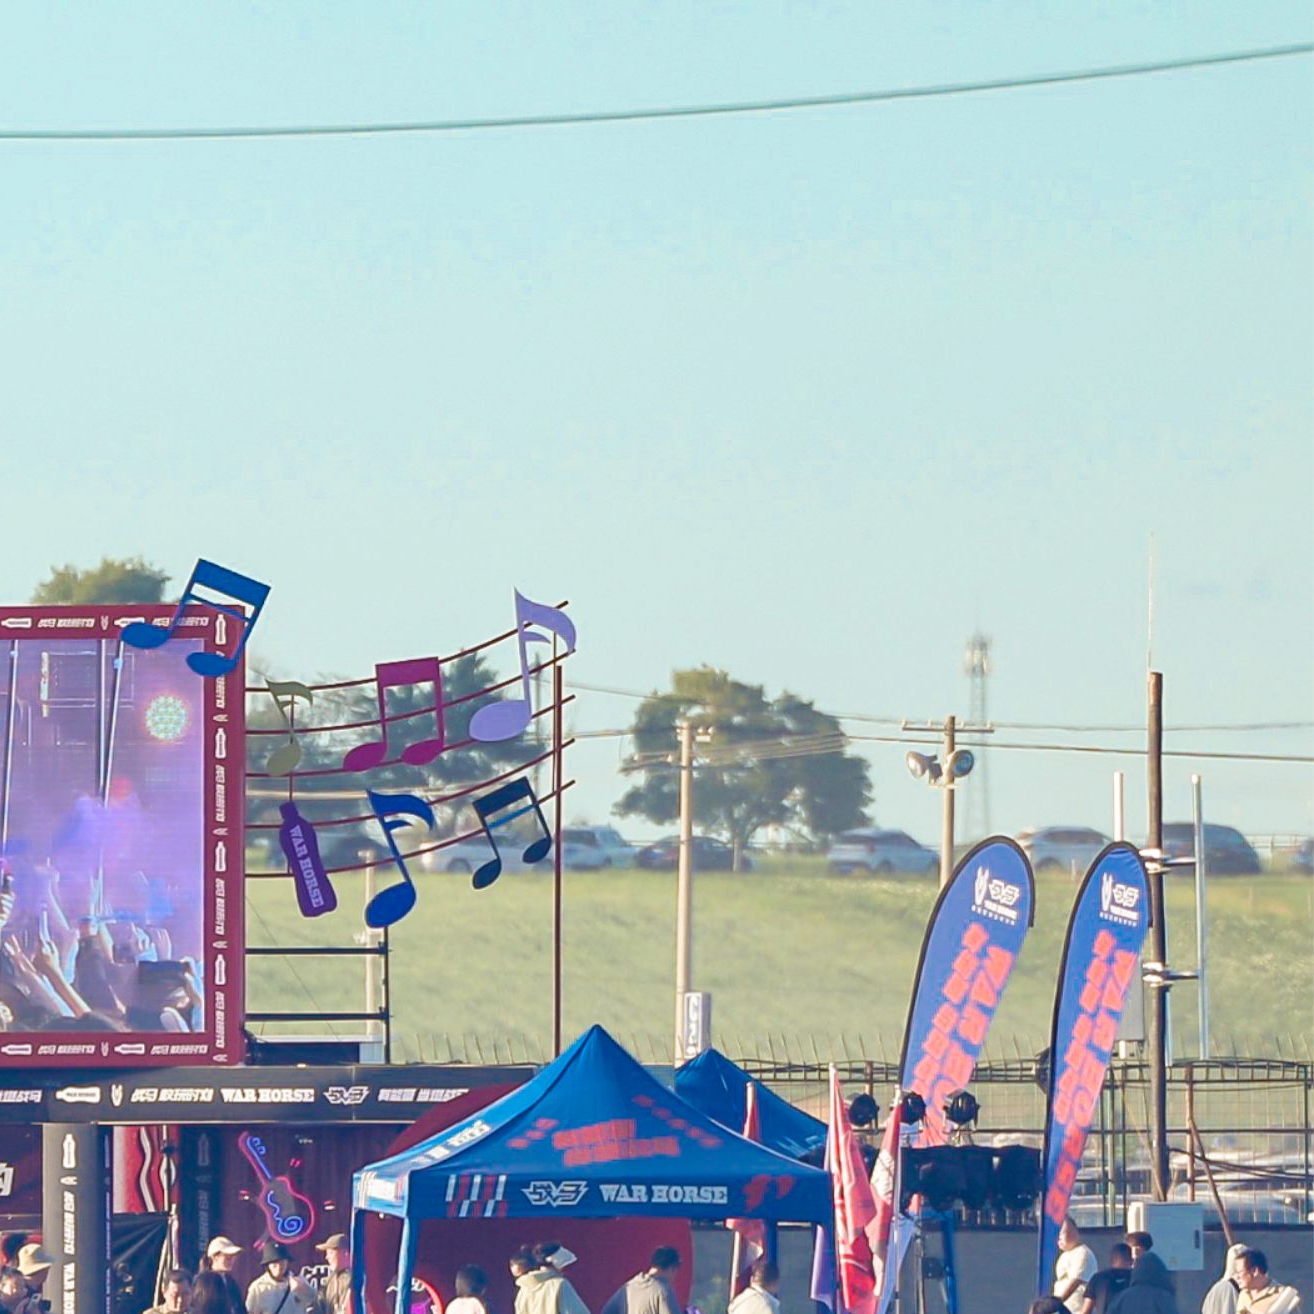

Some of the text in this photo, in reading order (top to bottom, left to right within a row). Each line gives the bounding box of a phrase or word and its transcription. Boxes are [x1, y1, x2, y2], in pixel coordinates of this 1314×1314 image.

[289, 825, 324, 908] WAR HORSE
[220, 1088, 315, 1103] WAR HORSE
[599, 1184, 728, 1204] WAR HORSE
[63, 1262, 75, 1290] WAR
